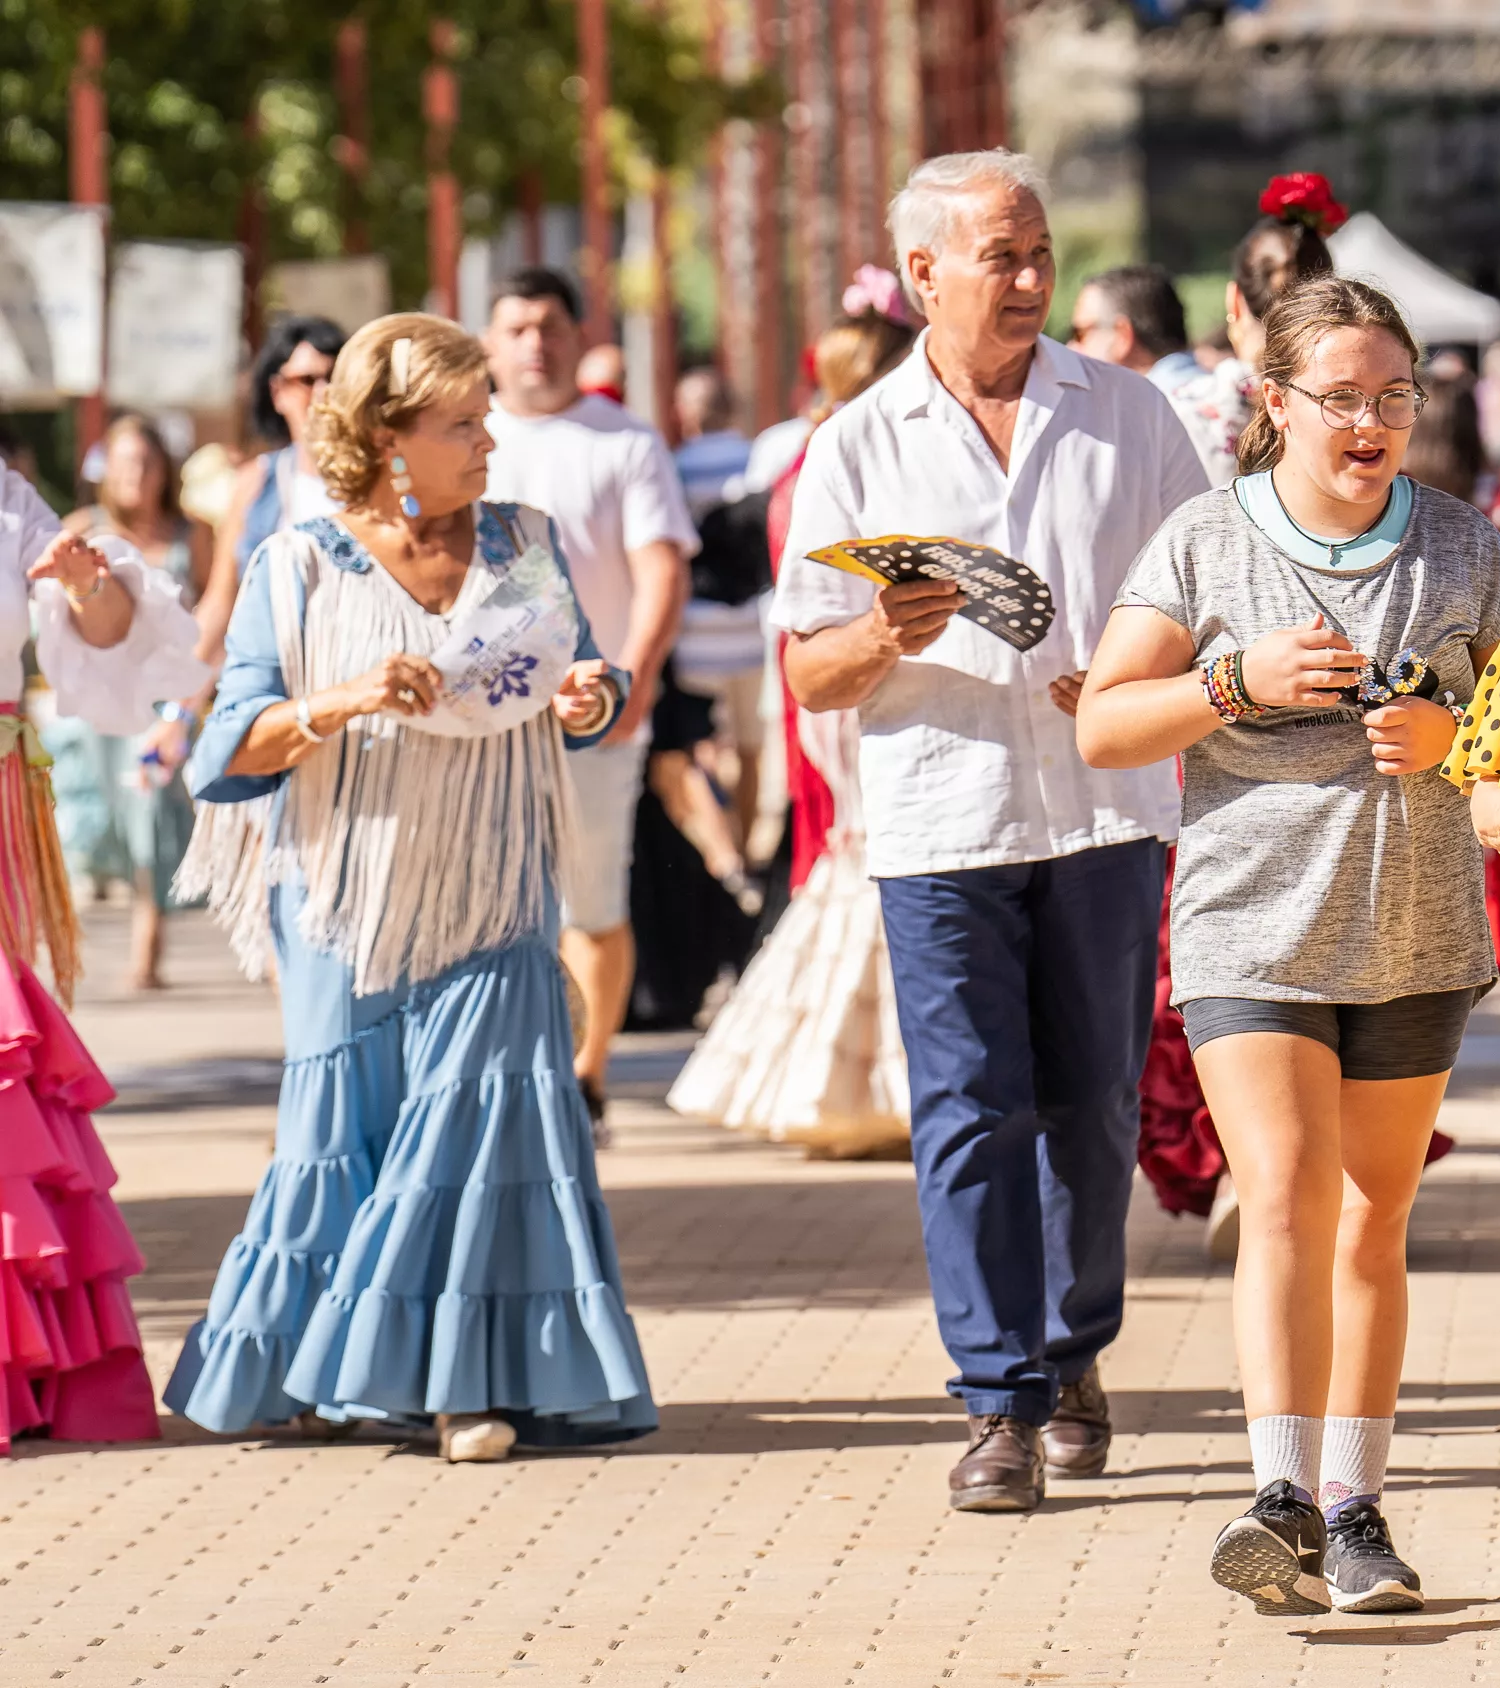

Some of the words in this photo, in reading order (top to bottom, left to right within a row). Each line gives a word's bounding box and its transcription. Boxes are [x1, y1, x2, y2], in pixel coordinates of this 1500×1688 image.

[920, 545, 975, 573] FEOS,
[968, 566, 1020, 590] NO!!
[1295, 709, 1349, 728] weekend,
